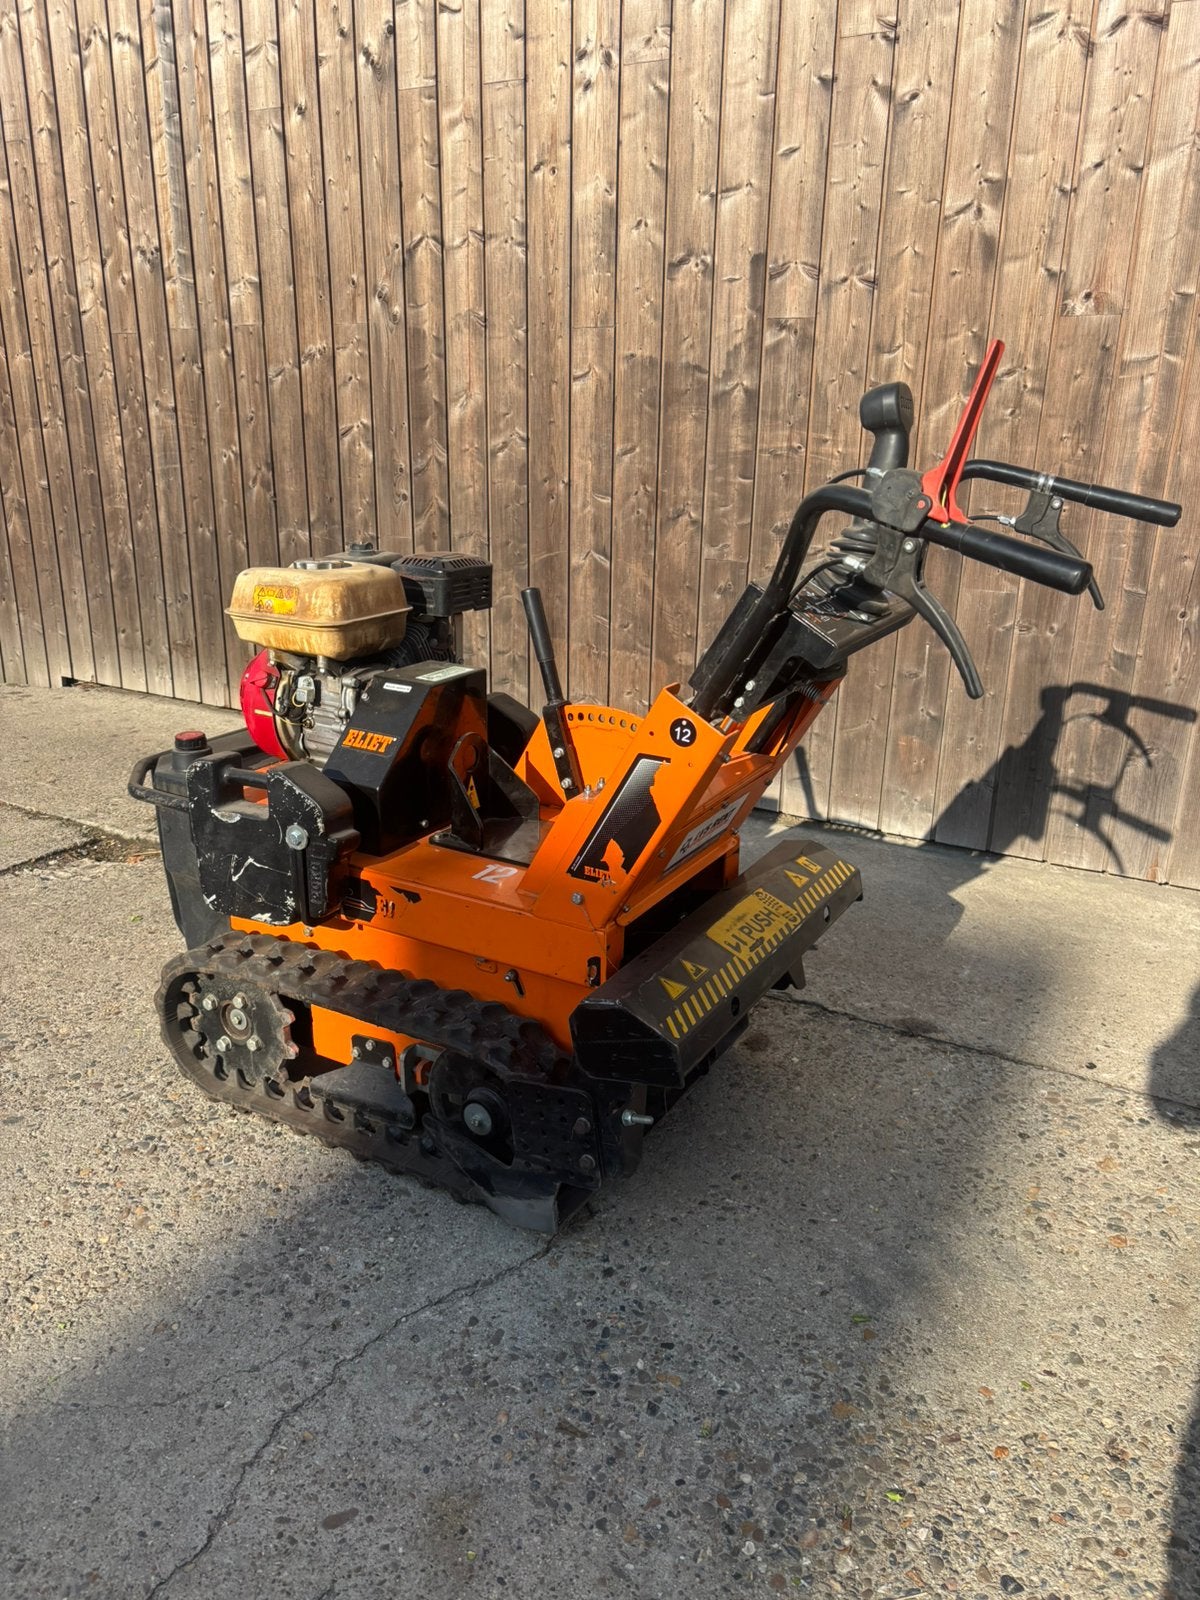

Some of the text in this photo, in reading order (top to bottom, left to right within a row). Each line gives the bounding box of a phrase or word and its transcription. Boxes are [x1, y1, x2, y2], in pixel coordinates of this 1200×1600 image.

[343, 729, 394, 753] ELIET
[675, 726, 691, 743] 12
[472, 864, 519, 884] 12
[738, 906, 781, 940] PUSH
